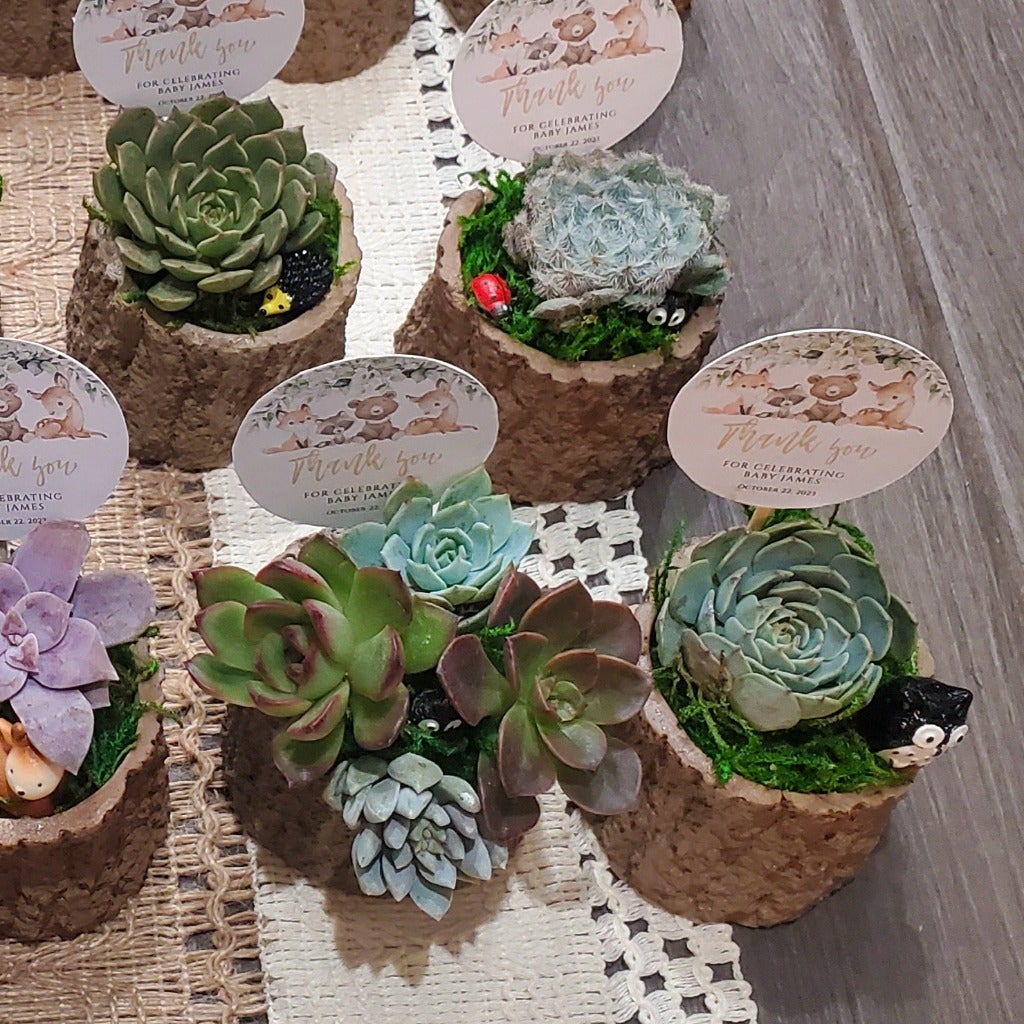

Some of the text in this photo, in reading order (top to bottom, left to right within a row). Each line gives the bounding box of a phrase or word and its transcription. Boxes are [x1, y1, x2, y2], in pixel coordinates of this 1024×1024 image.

[120, 31, 257, 75] Thank you
[137, 68, 241, 90] FOR CELEBRATING
[157, 79, 224, 95] BABY JAMES
[500, 69, 635, 118] Thank you
[513, 109, 617, 134] FOR CELEBRATING
[533, 122, 600, 140] BABY JAMES
[716, 419, 877, 465] Thank you
[32, 455, 78, 487] you
[289, 444, 443, 485] Thank you
[722, 460, 845, 479] FOR CELEBRATING
[743, 471, 822, 486] BABY JAMES
[304, 481, 401, 499] FOR CELEBRAT
[737, 483, 779, 493] OCTOBER
[6, 502, 45, 513] JAMES
[327, 494, 358, 504] BABY
[326, 506, 367, 516] OCTOBER
